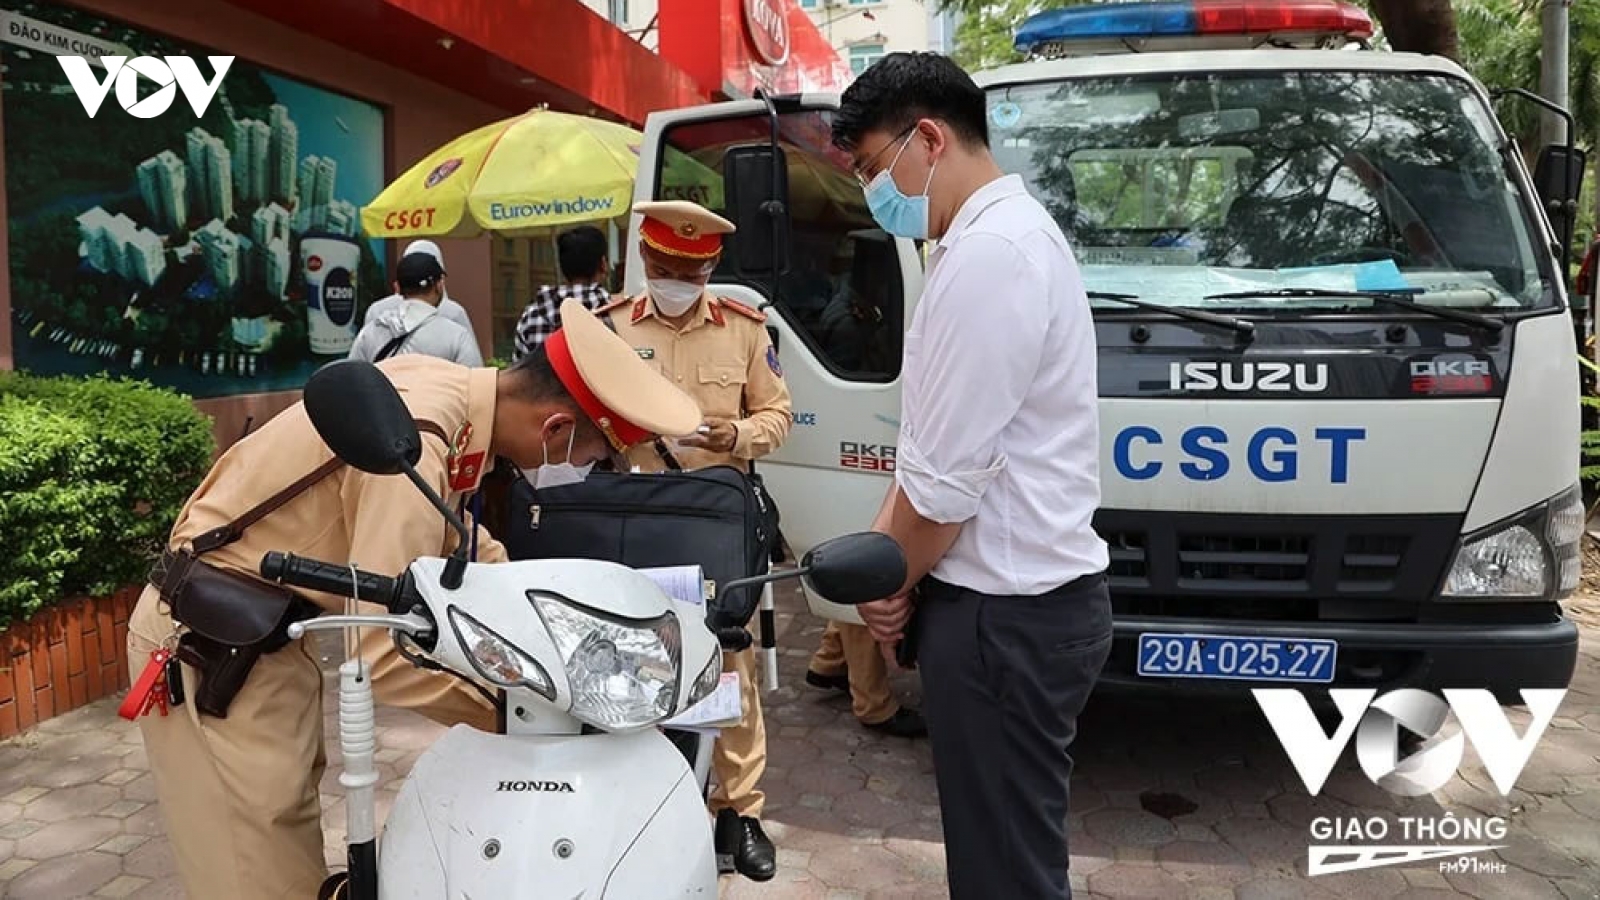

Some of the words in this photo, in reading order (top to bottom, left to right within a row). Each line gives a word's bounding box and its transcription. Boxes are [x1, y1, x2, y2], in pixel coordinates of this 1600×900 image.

[10, 21, 41, 41] ĐẢO
[44, 31, 69, 50] KIM
[384, 208, 435, 230] CSGT
[490, 196, 614, 221] Eurowindow
[1170, 361, 1328, 392] ISUZU
[1113, 425, 1367, 484] CSGT
[1143, 638, 1331, 677] 29A-025.27
[496, 780, 576, 793] HONDA
